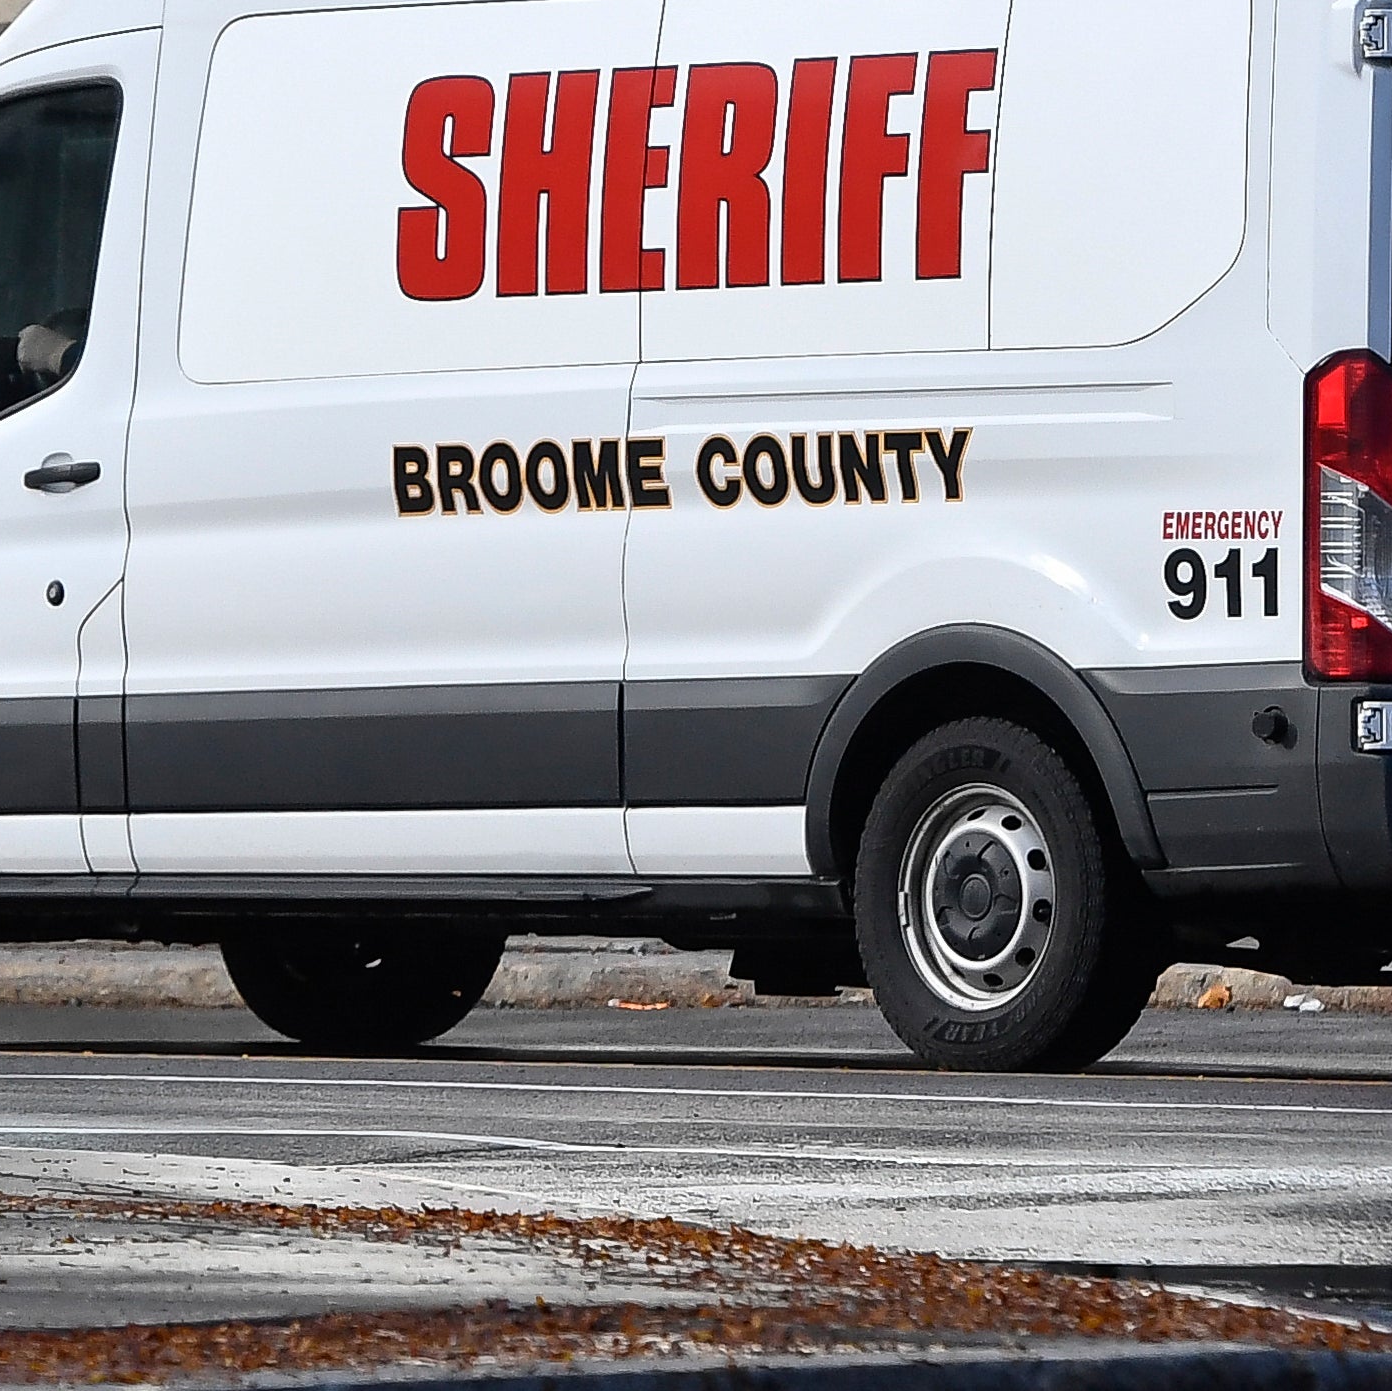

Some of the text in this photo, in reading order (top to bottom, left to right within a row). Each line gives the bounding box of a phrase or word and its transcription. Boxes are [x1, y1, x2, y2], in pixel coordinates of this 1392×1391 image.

[397, 48, 998, 301] SHERIFF
[393, 428, 973, 517] BROOME COUNTY
[1162, 510, 1283, 540] EMERGENCY
[1163, 547, 1280, 620] 911
